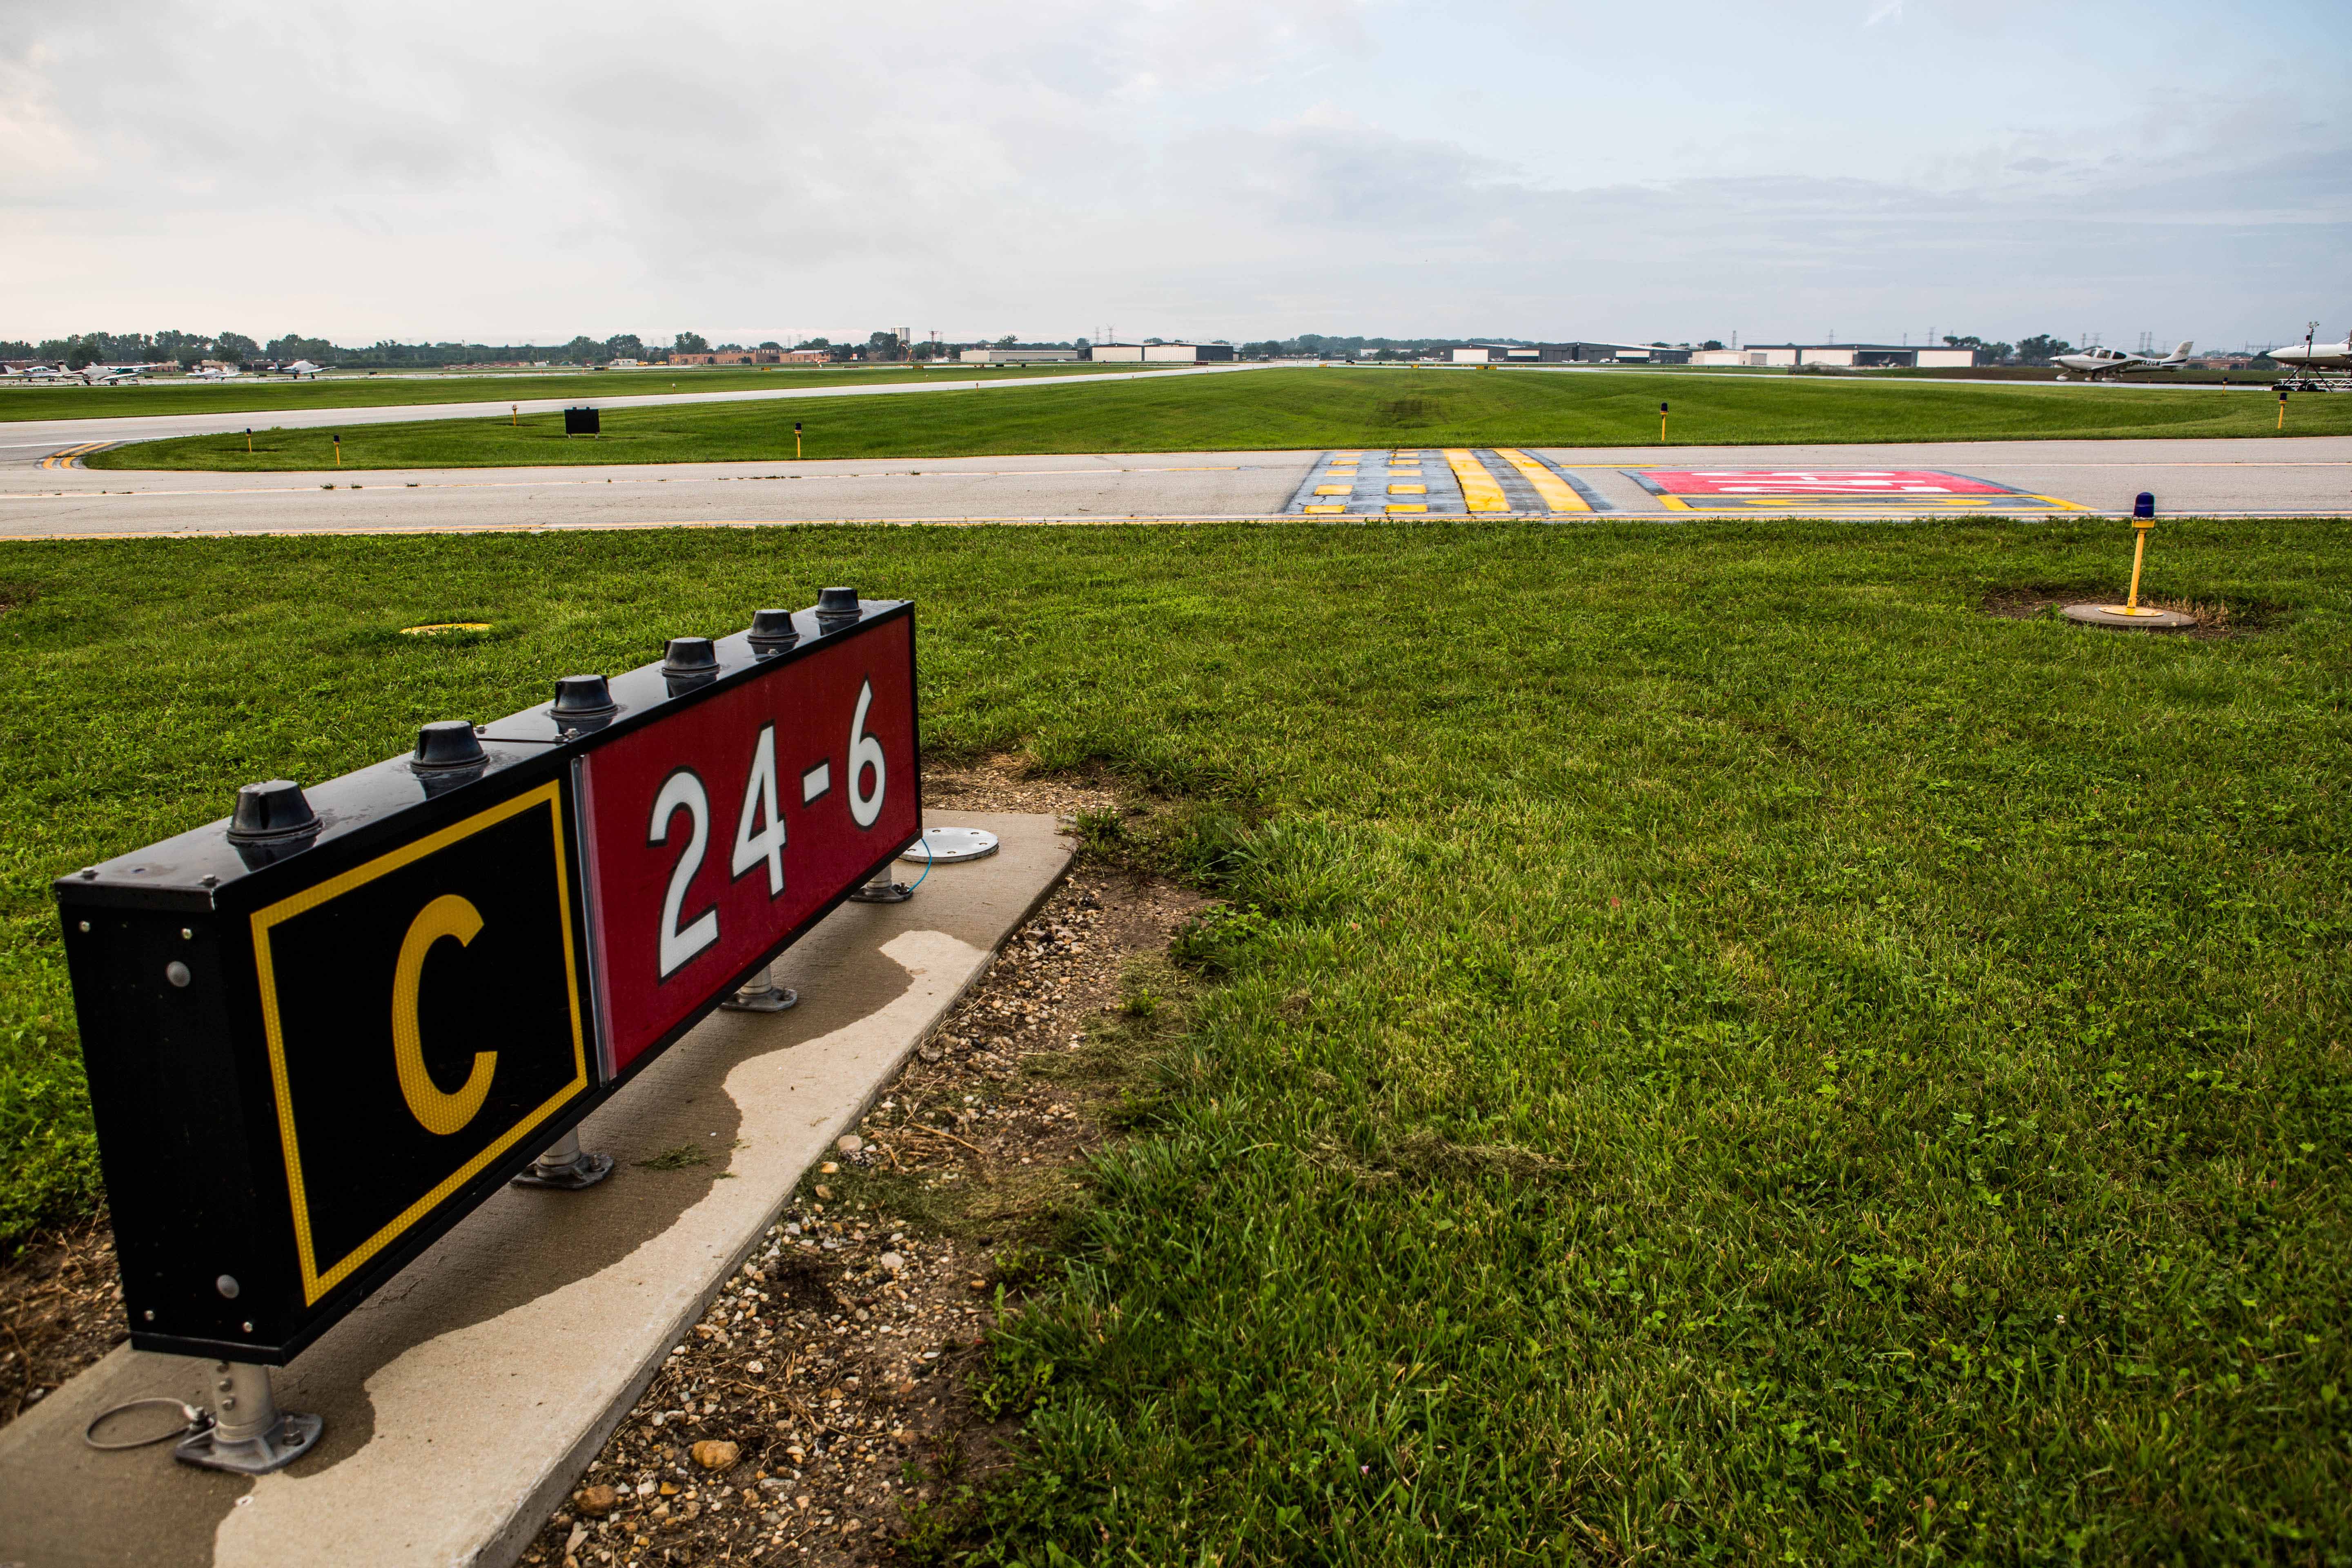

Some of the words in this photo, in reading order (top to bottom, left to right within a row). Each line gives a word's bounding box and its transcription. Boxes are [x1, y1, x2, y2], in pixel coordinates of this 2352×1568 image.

[1691, 472, 1952, 492] 24-6
[648, 679, 886, 979] 24-6
[392, 894, 497, 1136] C
